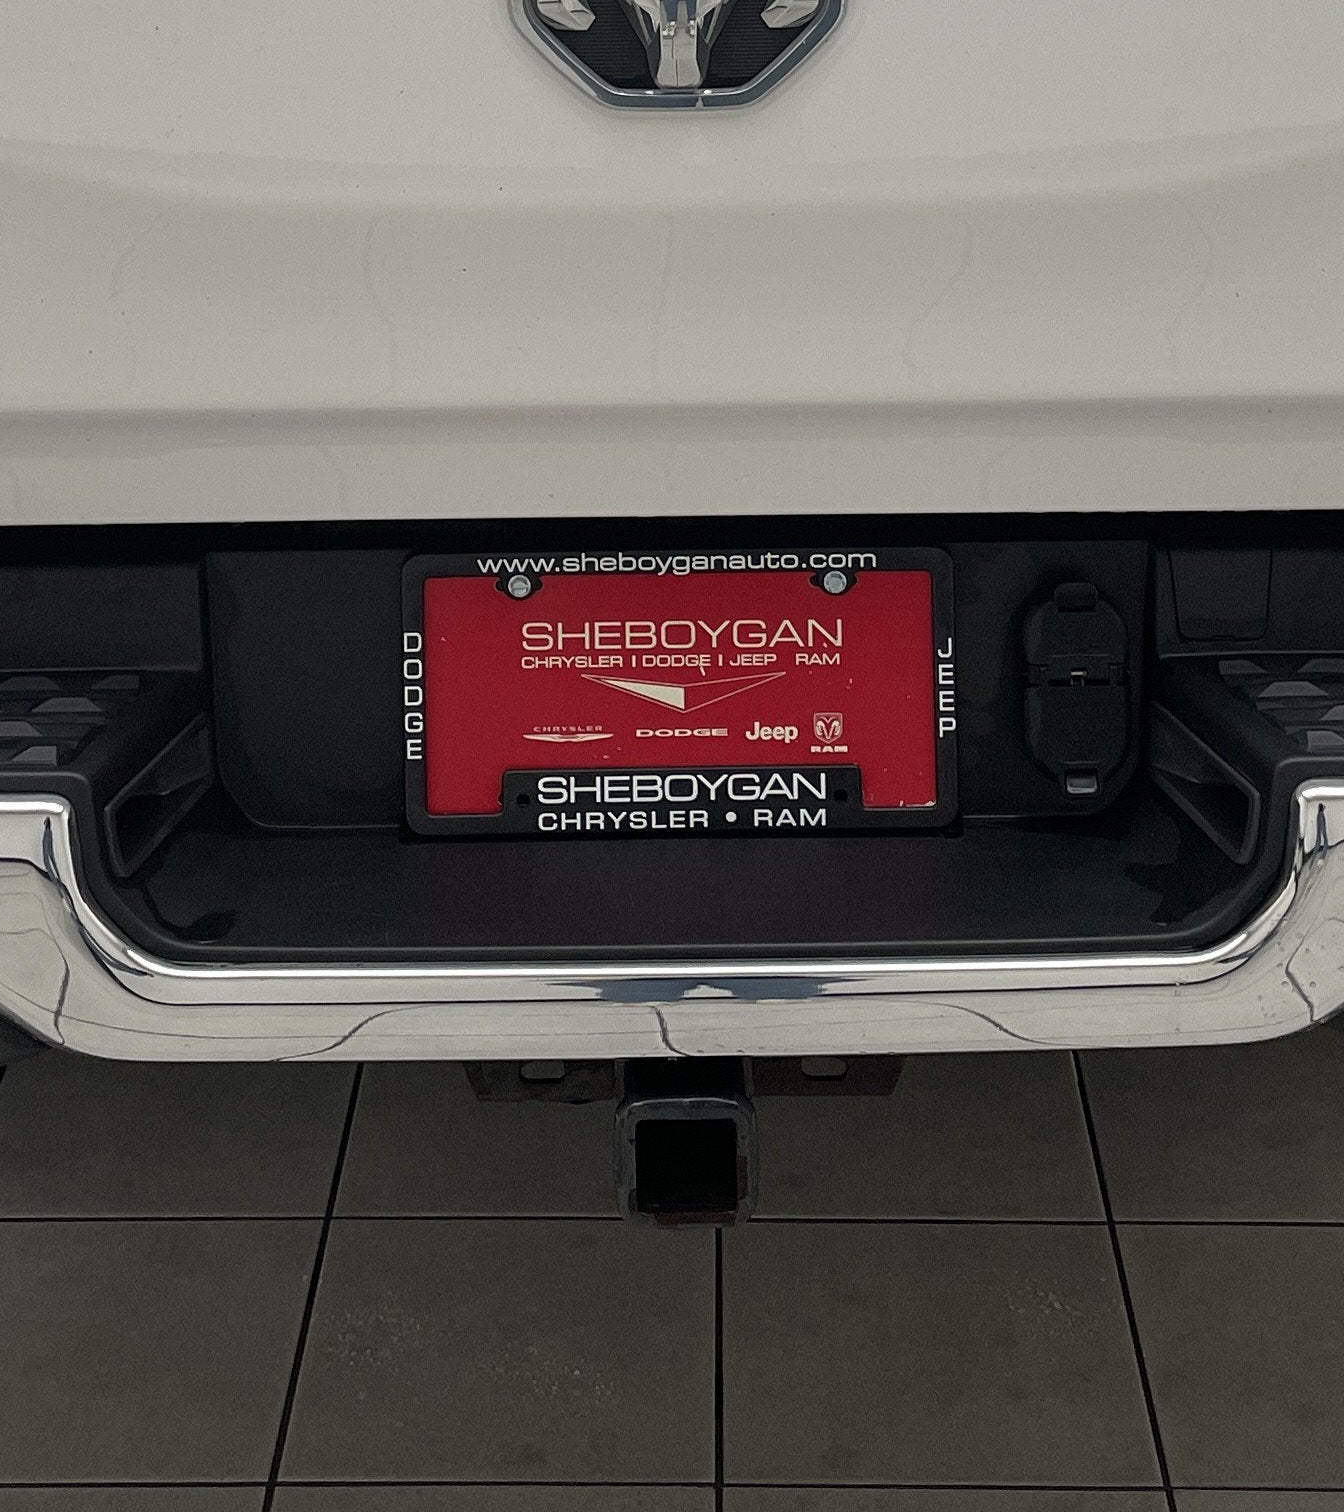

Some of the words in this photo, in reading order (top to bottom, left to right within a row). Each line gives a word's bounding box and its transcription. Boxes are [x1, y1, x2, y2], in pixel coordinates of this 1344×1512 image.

[476, 550, 878, 576] www.sheboyganauto.com
[521, 618, 843, 651] SHEBOYGAN
[521, 654, 624, 669] CHRYSLER
[642, 654, 711, 668] DODGE
[729, 653, 778, 667] JEEP
[795, 652, 841, 666] RAM
[402, 631, 424, 761] DODGE
[937, 636, 957, 739] JEEP
[533, 725, 604, 733] CHRYSLER
[635, 727, 729, 738] DODGE
[745, 721, 799, 744] Jeep
[810, 745, 849, 753] RAM
[537, 772, 827, 804] SHEBOYGAN
[538, 811, 710, 831] CHRYSLER
[753, 808, 828, 828] RAM
